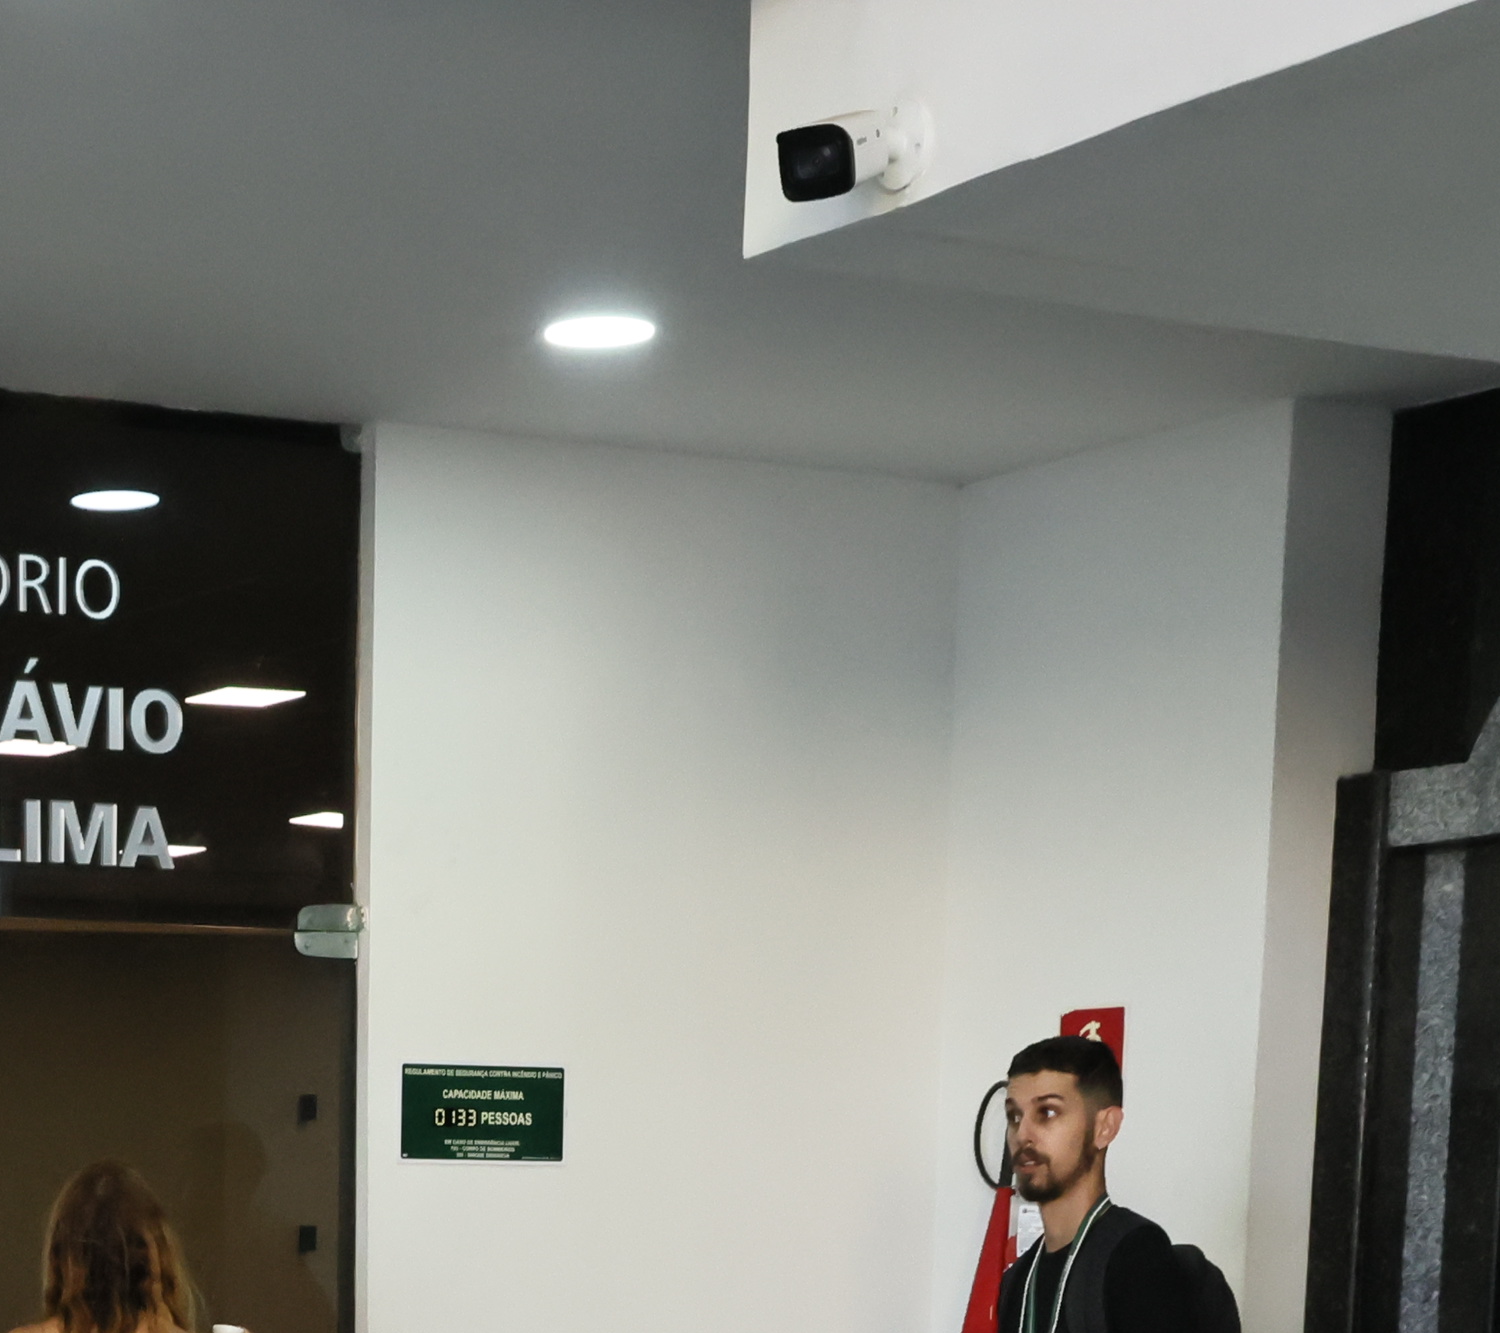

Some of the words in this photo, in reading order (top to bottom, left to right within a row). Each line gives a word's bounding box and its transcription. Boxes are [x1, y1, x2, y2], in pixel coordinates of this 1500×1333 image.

[442, 1089, 492, 1100] CAPACIDADE
[494, 1089, 524, 1100] MÁXIMA
[481, 1111, 532, 1126] PESSOAS
